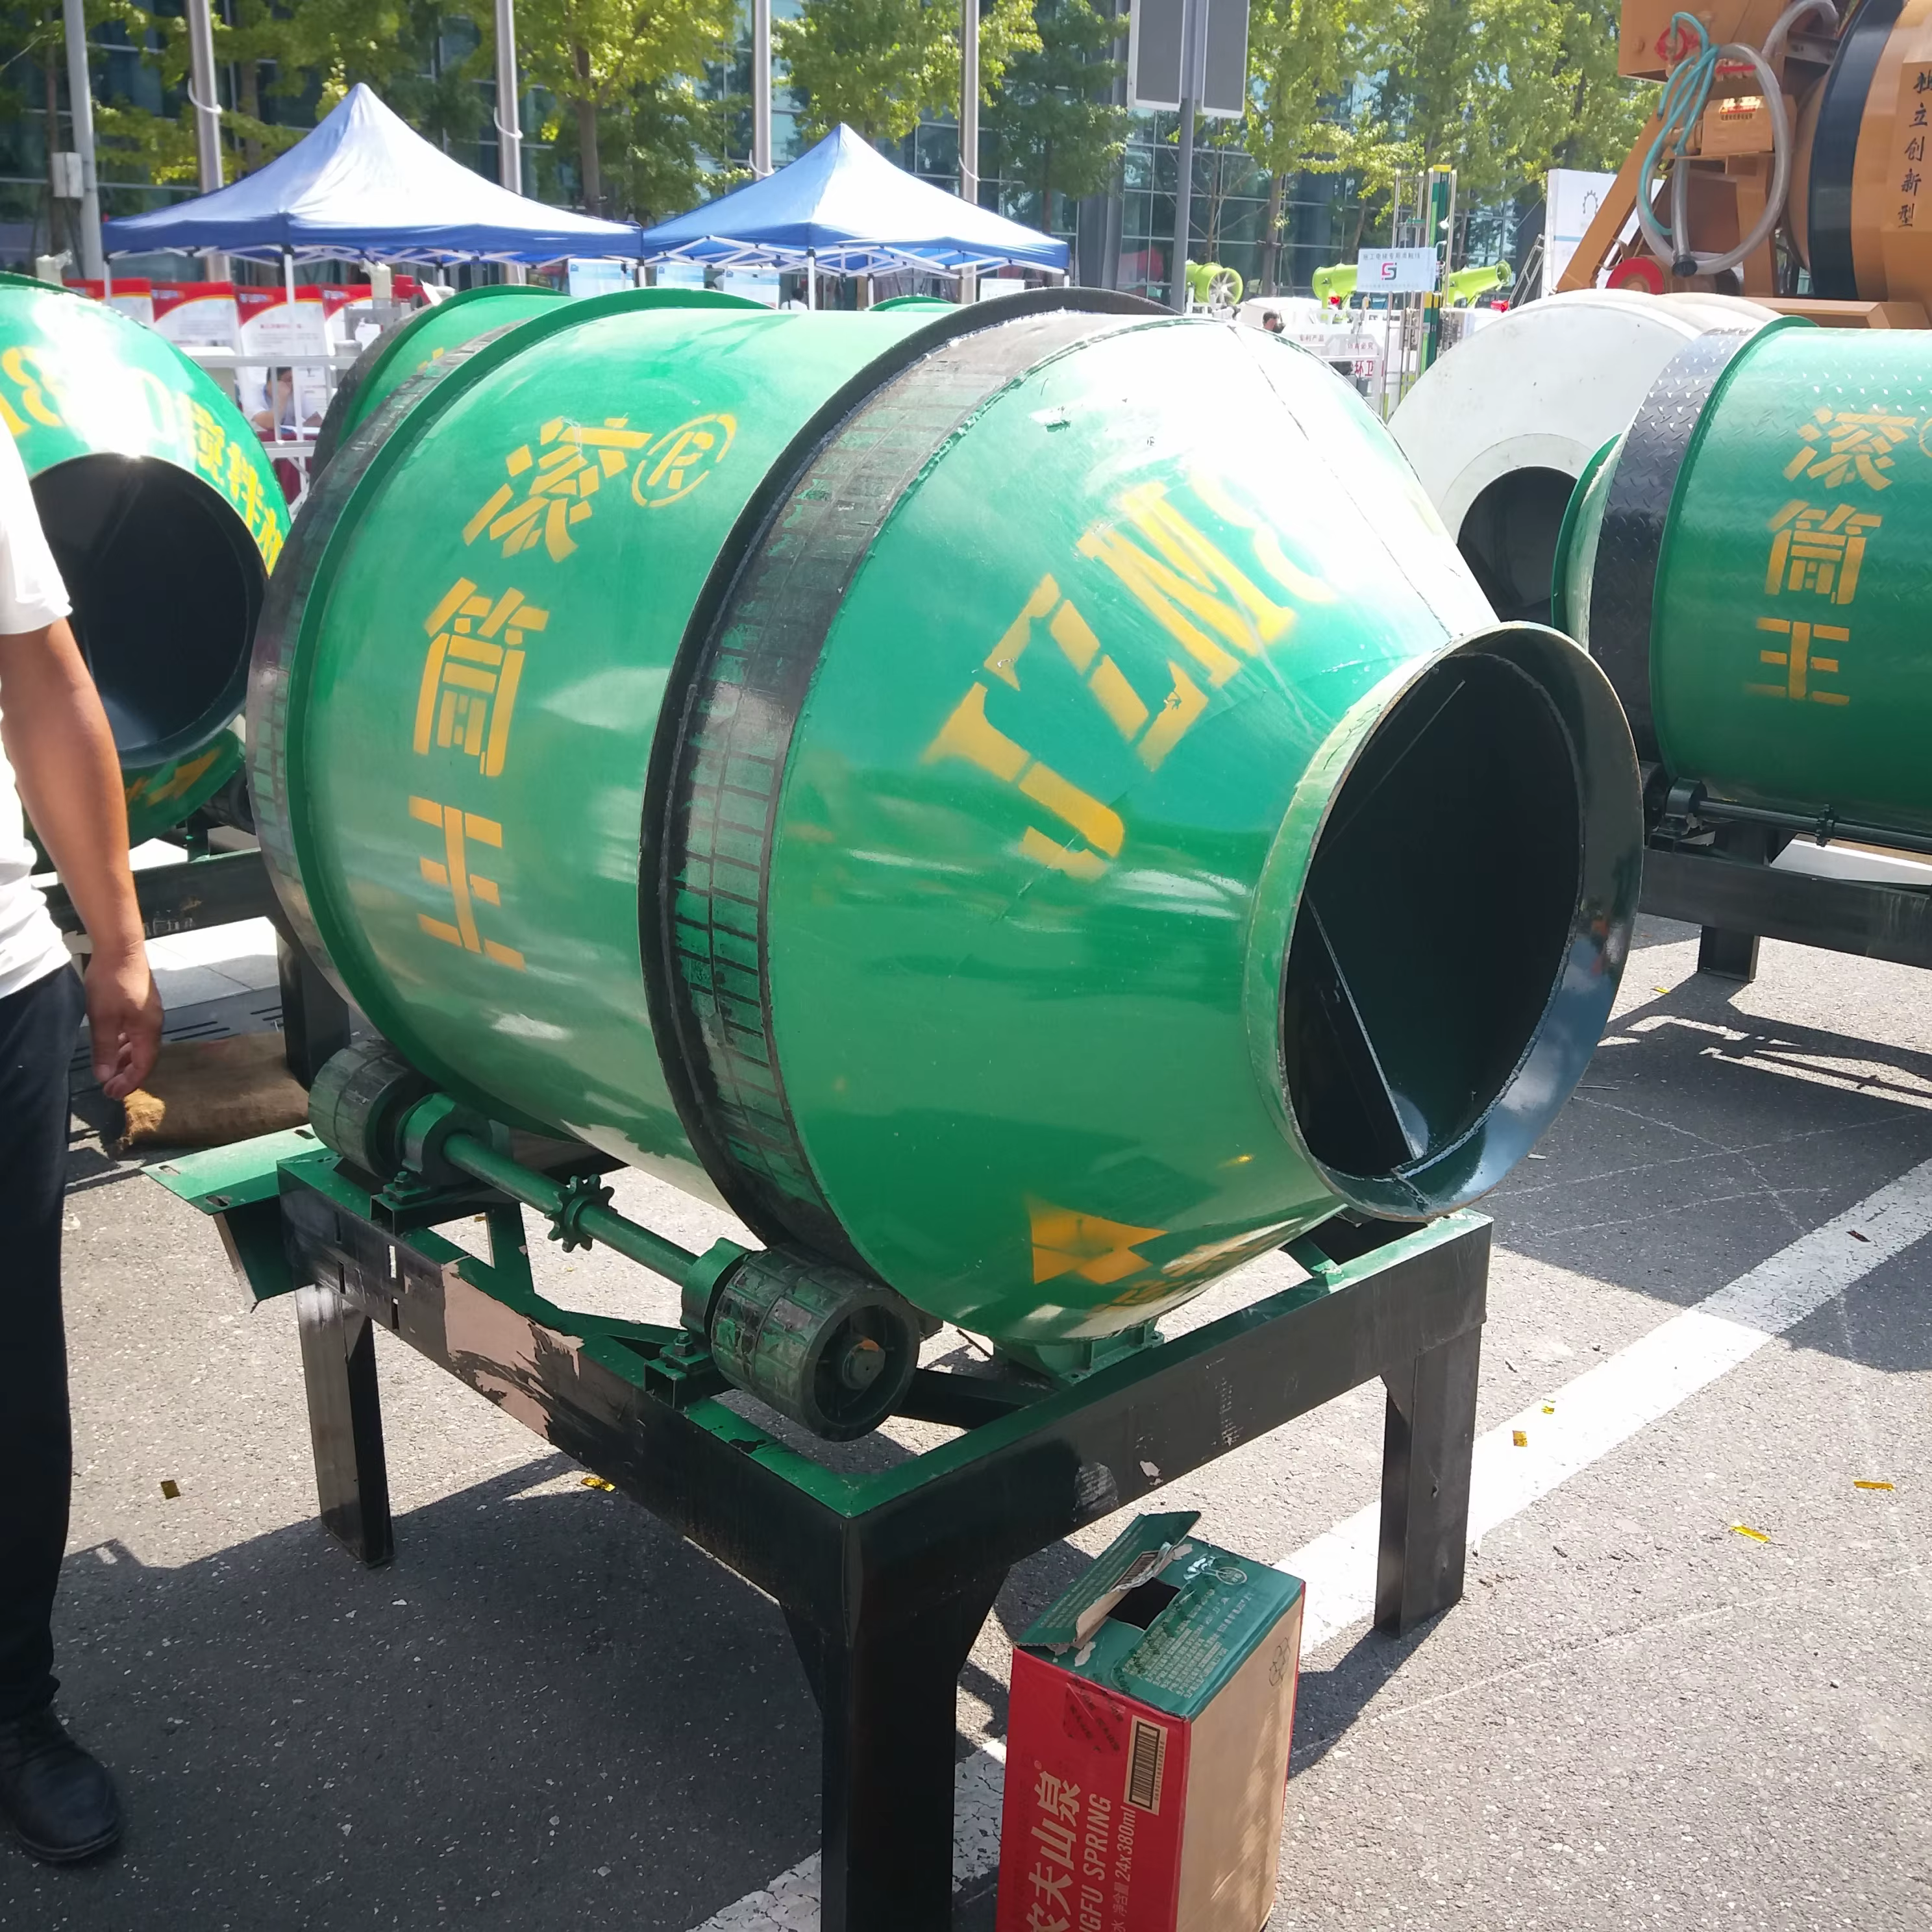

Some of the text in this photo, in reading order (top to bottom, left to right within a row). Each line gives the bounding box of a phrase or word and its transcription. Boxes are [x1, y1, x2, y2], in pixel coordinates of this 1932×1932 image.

[1082, 1793, 1111, 1881] SPRING
[1112, 1881, 1130, 1916] 净含量
